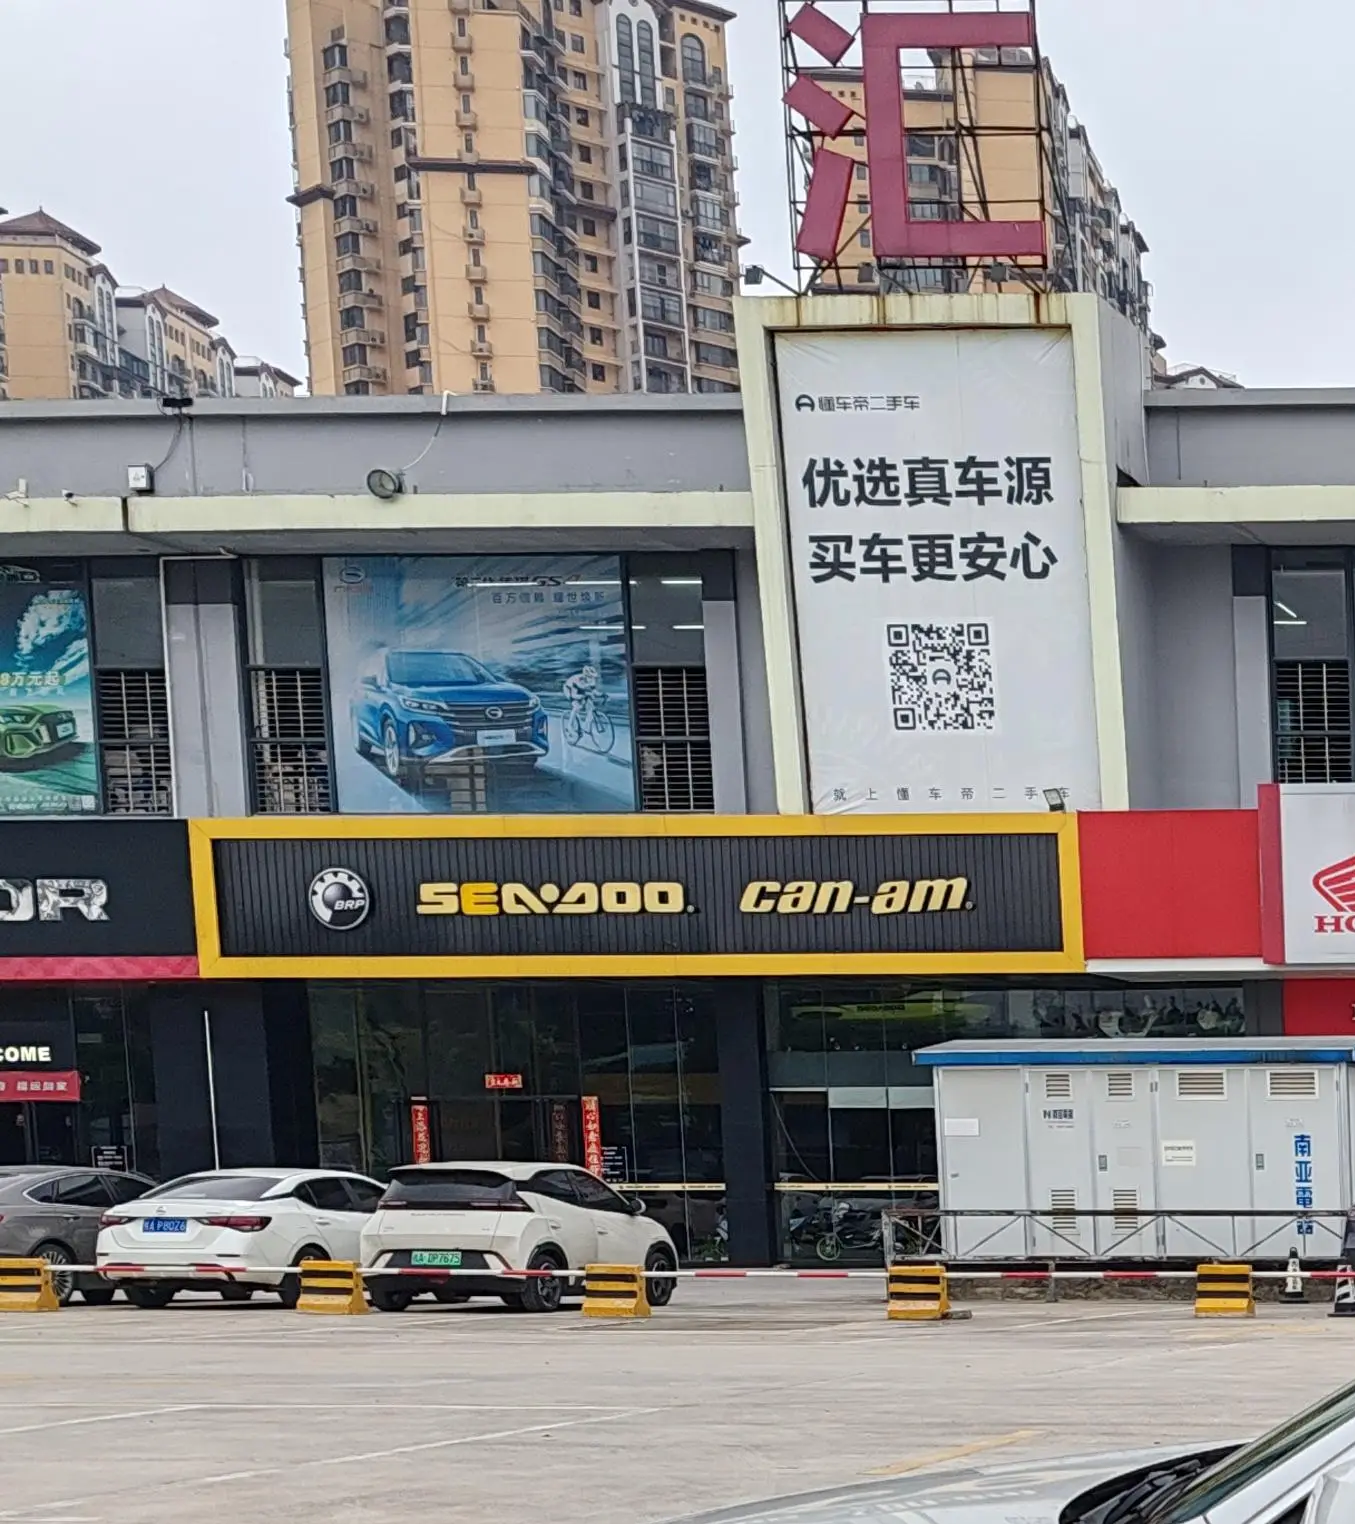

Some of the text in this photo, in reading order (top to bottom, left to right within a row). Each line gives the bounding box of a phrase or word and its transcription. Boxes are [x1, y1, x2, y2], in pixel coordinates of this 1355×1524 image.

[783, 2, 1048, 260] 汇
[818, 395, 920, 412] 懂车帝二手车
[801, 455, 1055, 508] 优选真车源
[808, 531, 1059, 583] 买车更安心
[333, 899, 366, 911] BRP
